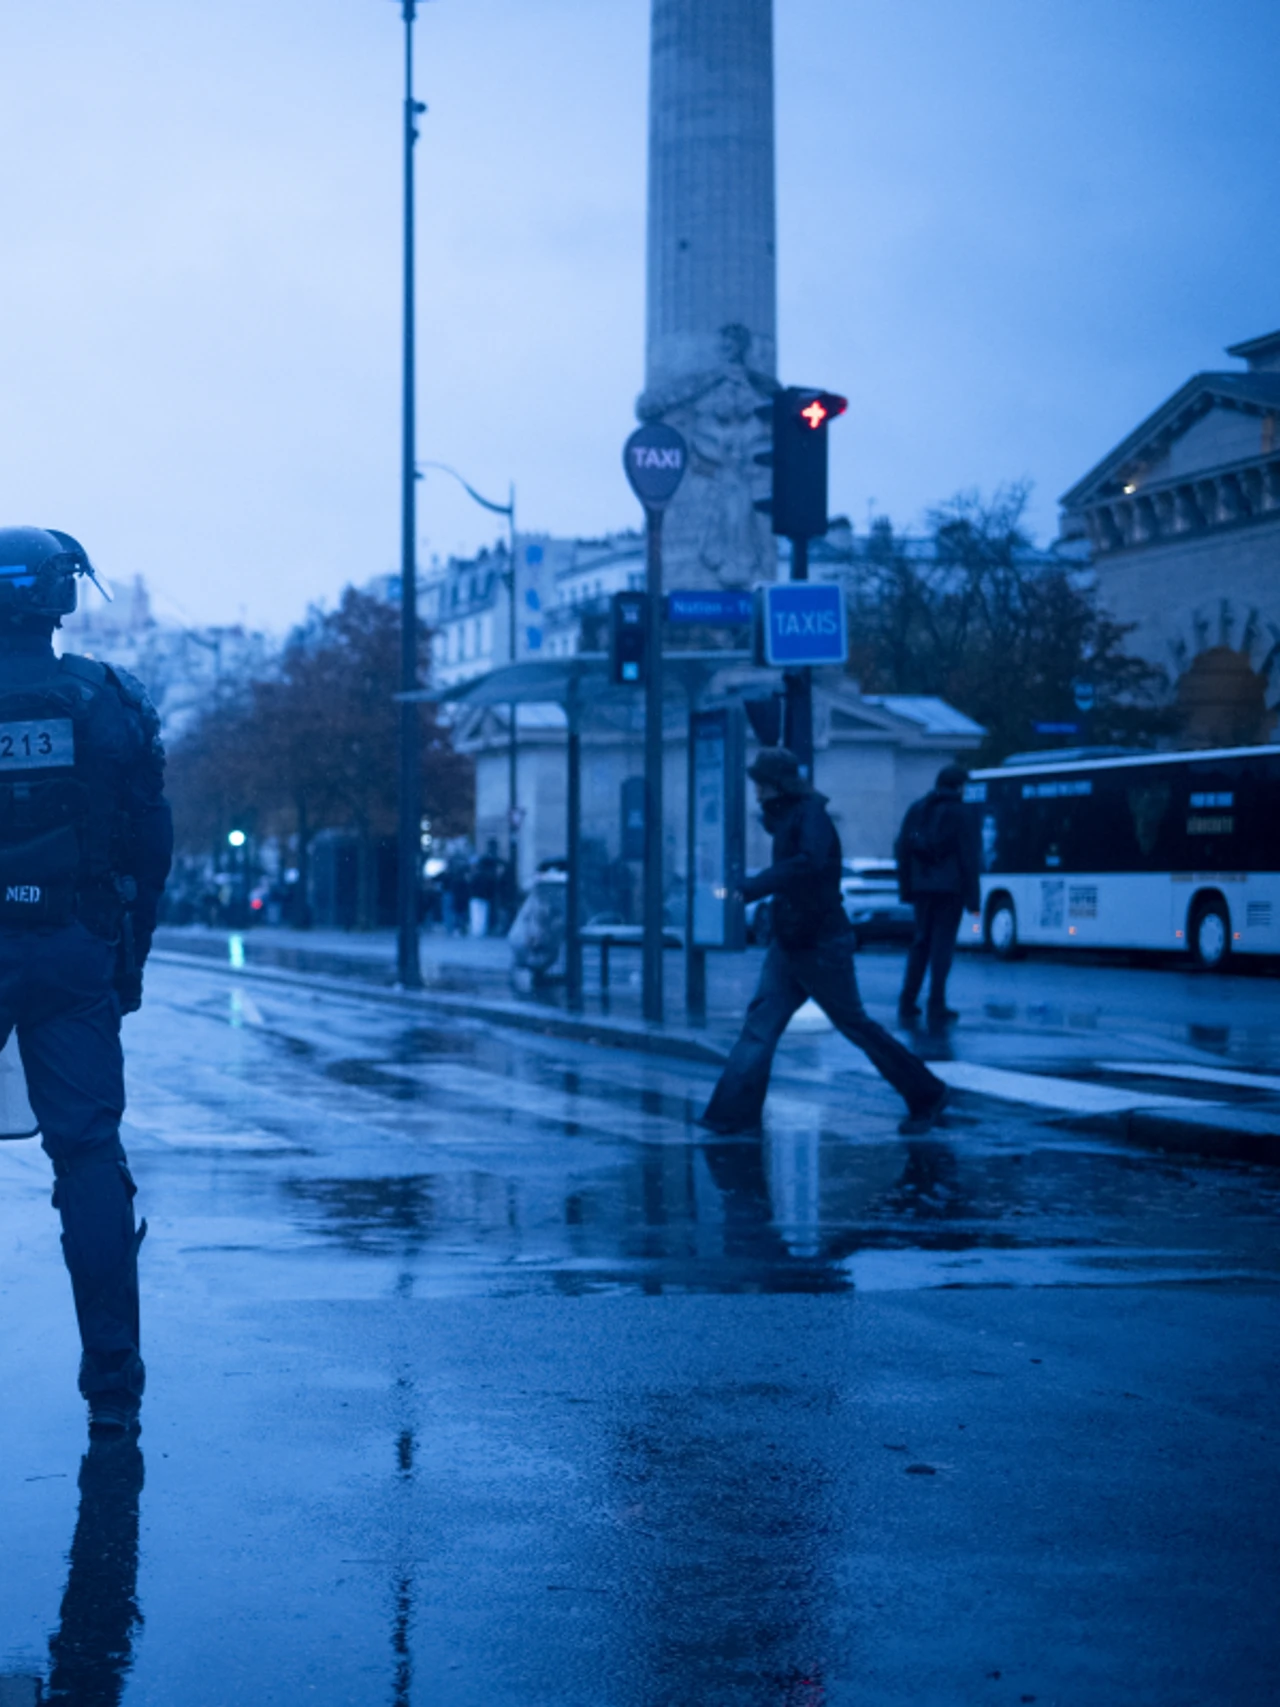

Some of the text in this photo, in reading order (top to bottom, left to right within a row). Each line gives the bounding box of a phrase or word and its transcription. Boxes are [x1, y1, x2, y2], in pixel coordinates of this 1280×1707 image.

[632, 446, 681, 469] TAXI
[774, 610, 837, 637] TAXIS
[0, 732, 52, 757] 213
